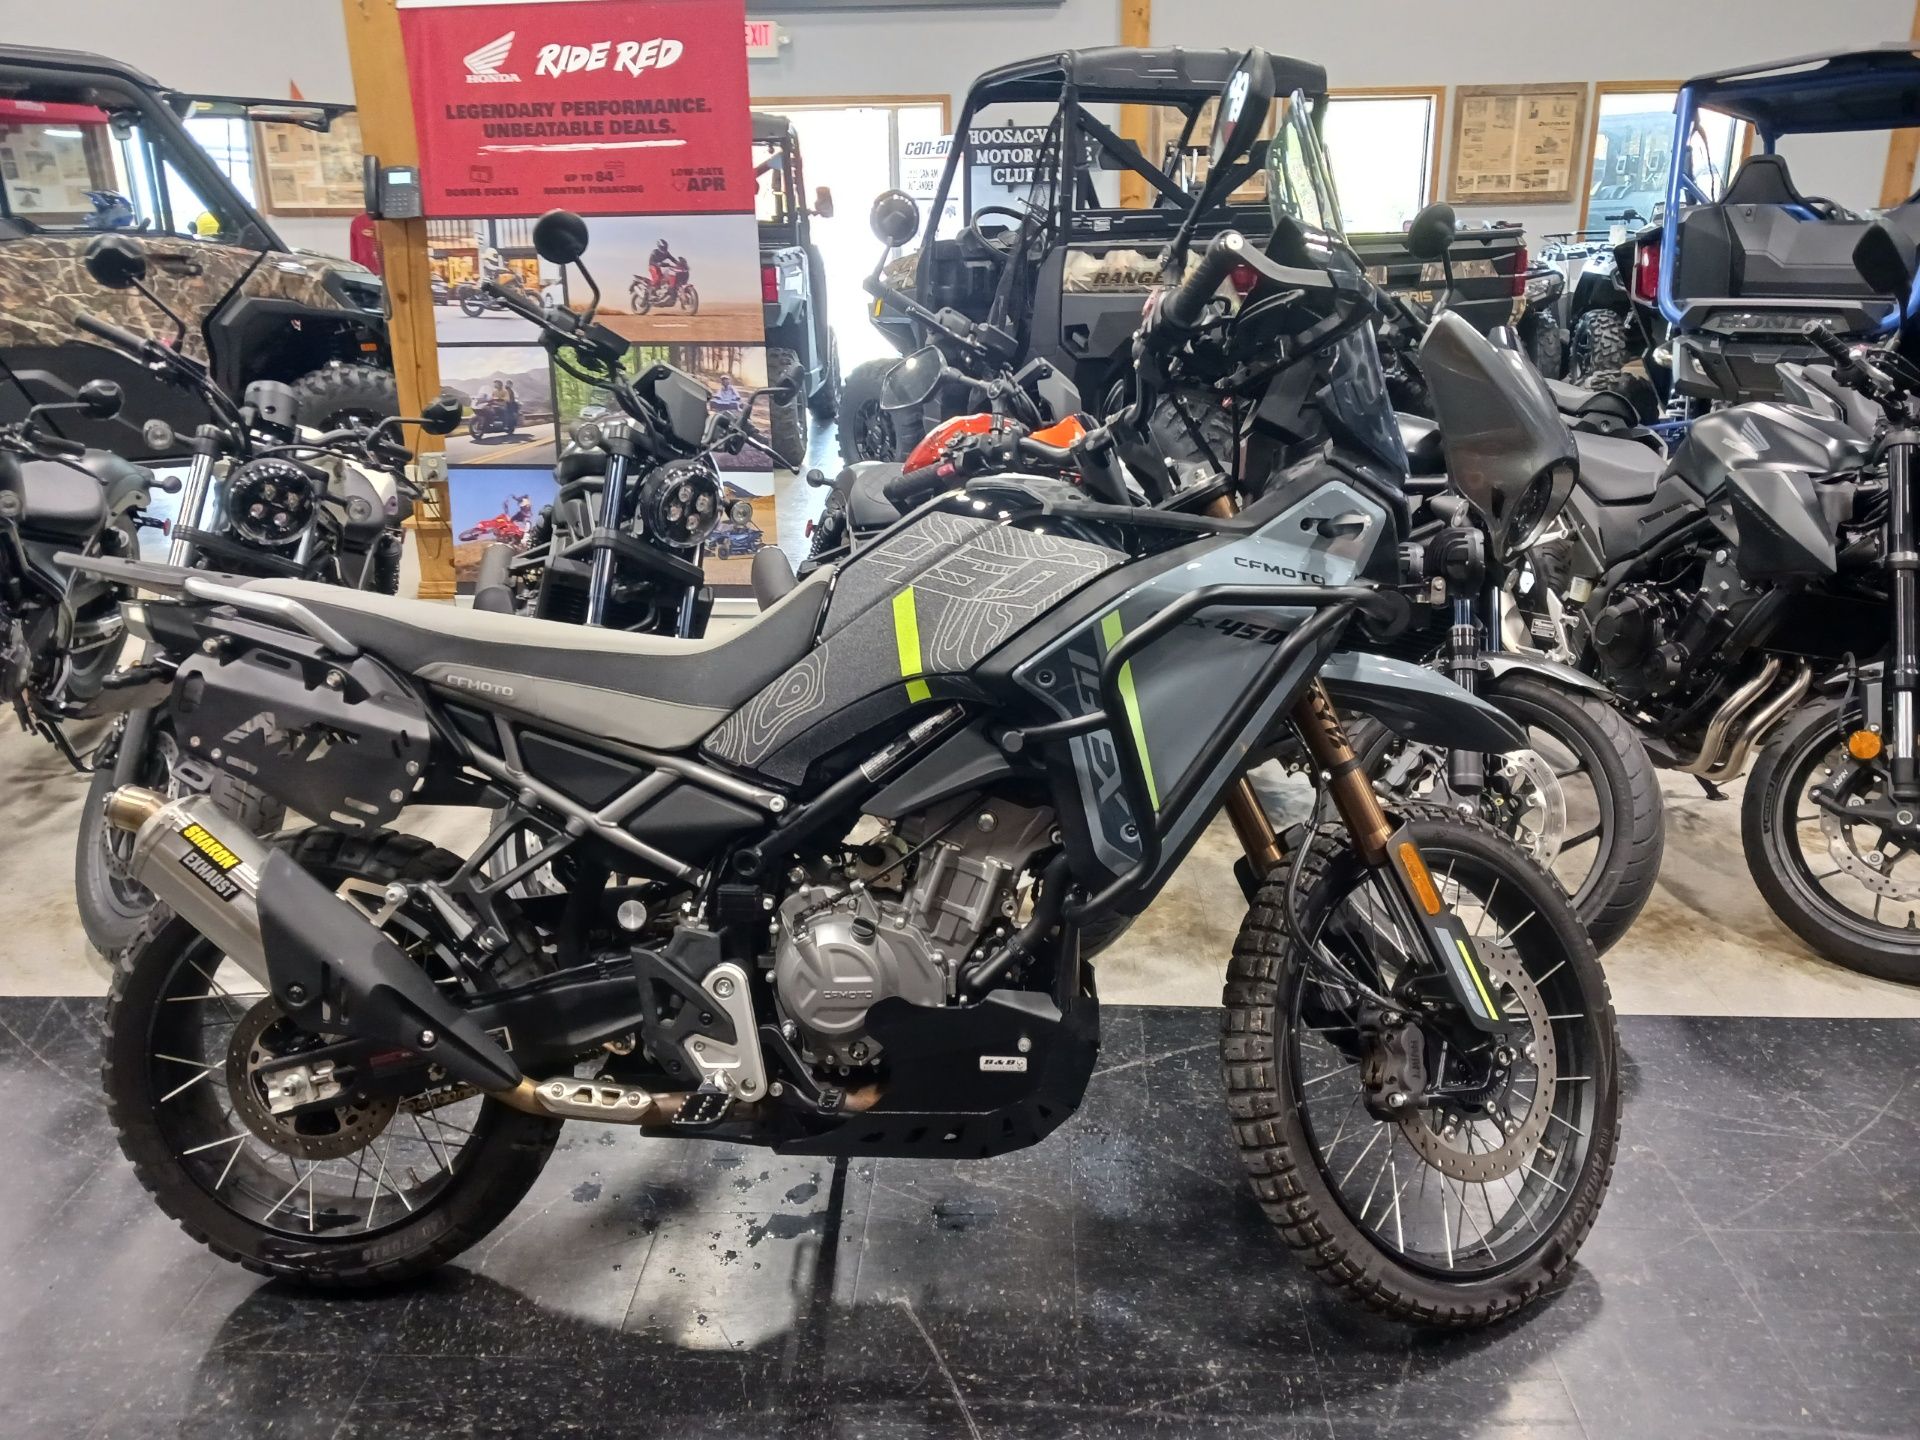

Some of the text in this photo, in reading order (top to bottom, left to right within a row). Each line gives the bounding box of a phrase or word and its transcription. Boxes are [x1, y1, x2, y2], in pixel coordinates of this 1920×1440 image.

[535, 37, 684, 78] RIDE RED
[465, 74, 522, 83] HONDA
[446, 98, 712, 120] LEGENDARY PERFORMANCE.
[483, 118, 676, 138] UNBEATABLE DEALS.
[976, 148, 1034, 164] MOTOR
[687, 177, 726, 192] APR
[1093, 271, 1164, 284] RANGE
[1234, 556, 1326, 586] CFMOTO
[447, 674, 514, 697] CFMOTO
[182, 851, 239, 897] EXHAUST
